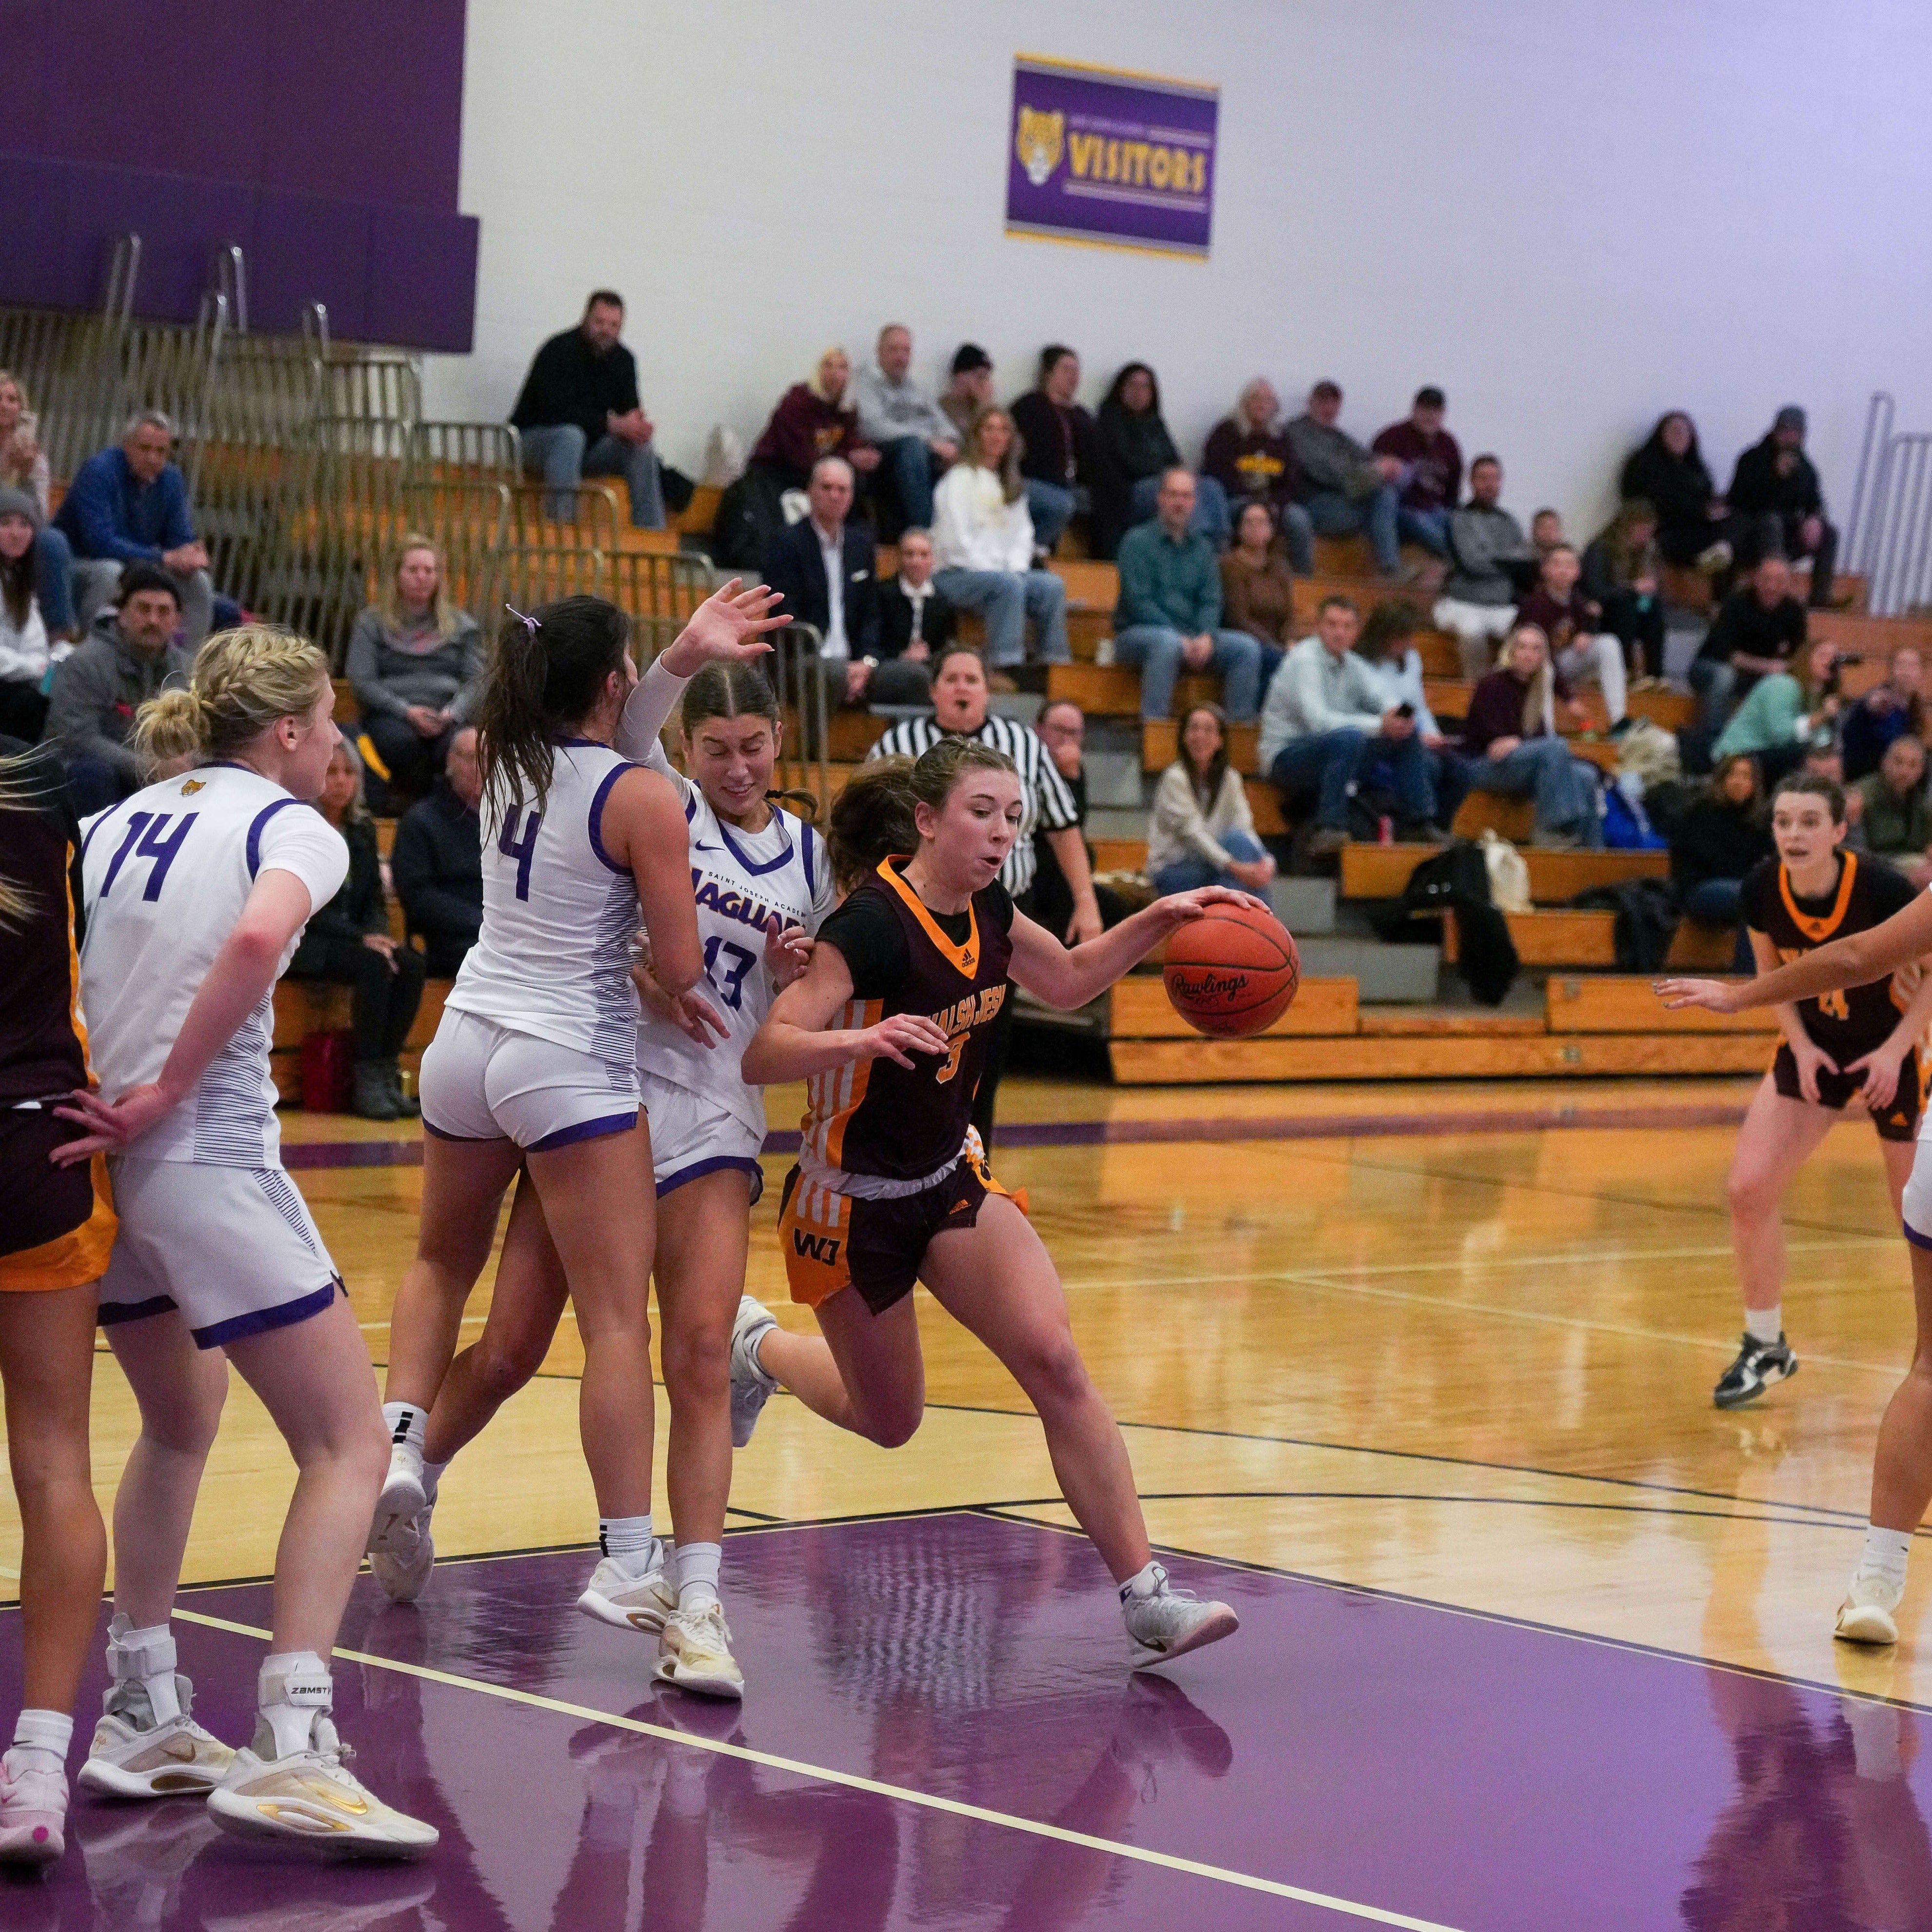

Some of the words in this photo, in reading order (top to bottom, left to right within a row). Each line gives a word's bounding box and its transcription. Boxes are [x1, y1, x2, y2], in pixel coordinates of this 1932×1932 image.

[1069, 131, 1206, 193] VISITORS
[99, 811, 199, 902] 14
[499, 803, 542, 902] 4
[691, 867, 806, 934] AGUA
[708, 871, 736, 886] SAINT
[739, 885, 769, 903] JOSEPH
[704, 936, 757, 1012] 13
[1171, 973, 1249, 1002] Rawlings
[926, 994, 976, 1036] ALSH
[794, 1227, 841, 1266] WJ
